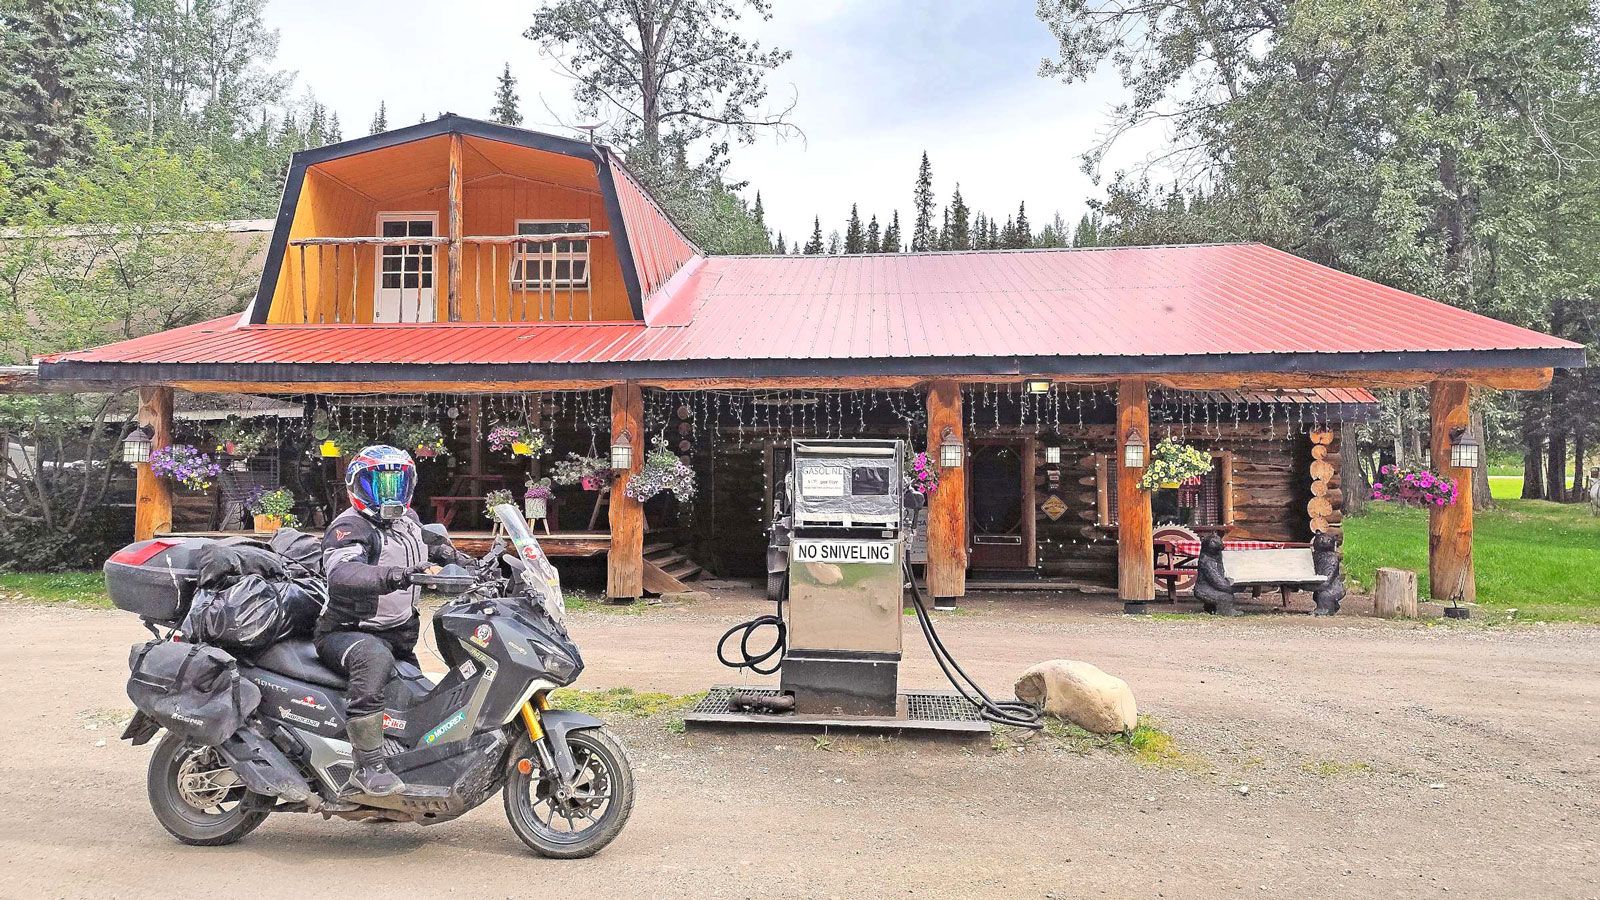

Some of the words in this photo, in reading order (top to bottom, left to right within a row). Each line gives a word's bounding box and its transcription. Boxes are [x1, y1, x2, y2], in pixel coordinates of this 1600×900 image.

[803, 466, 842, 475] GASOLINE
[799, 545, 817, 558] NO
[821, 545, 889, 559] SNIVELING
[434, 712, 463, 737] MOTOREX
